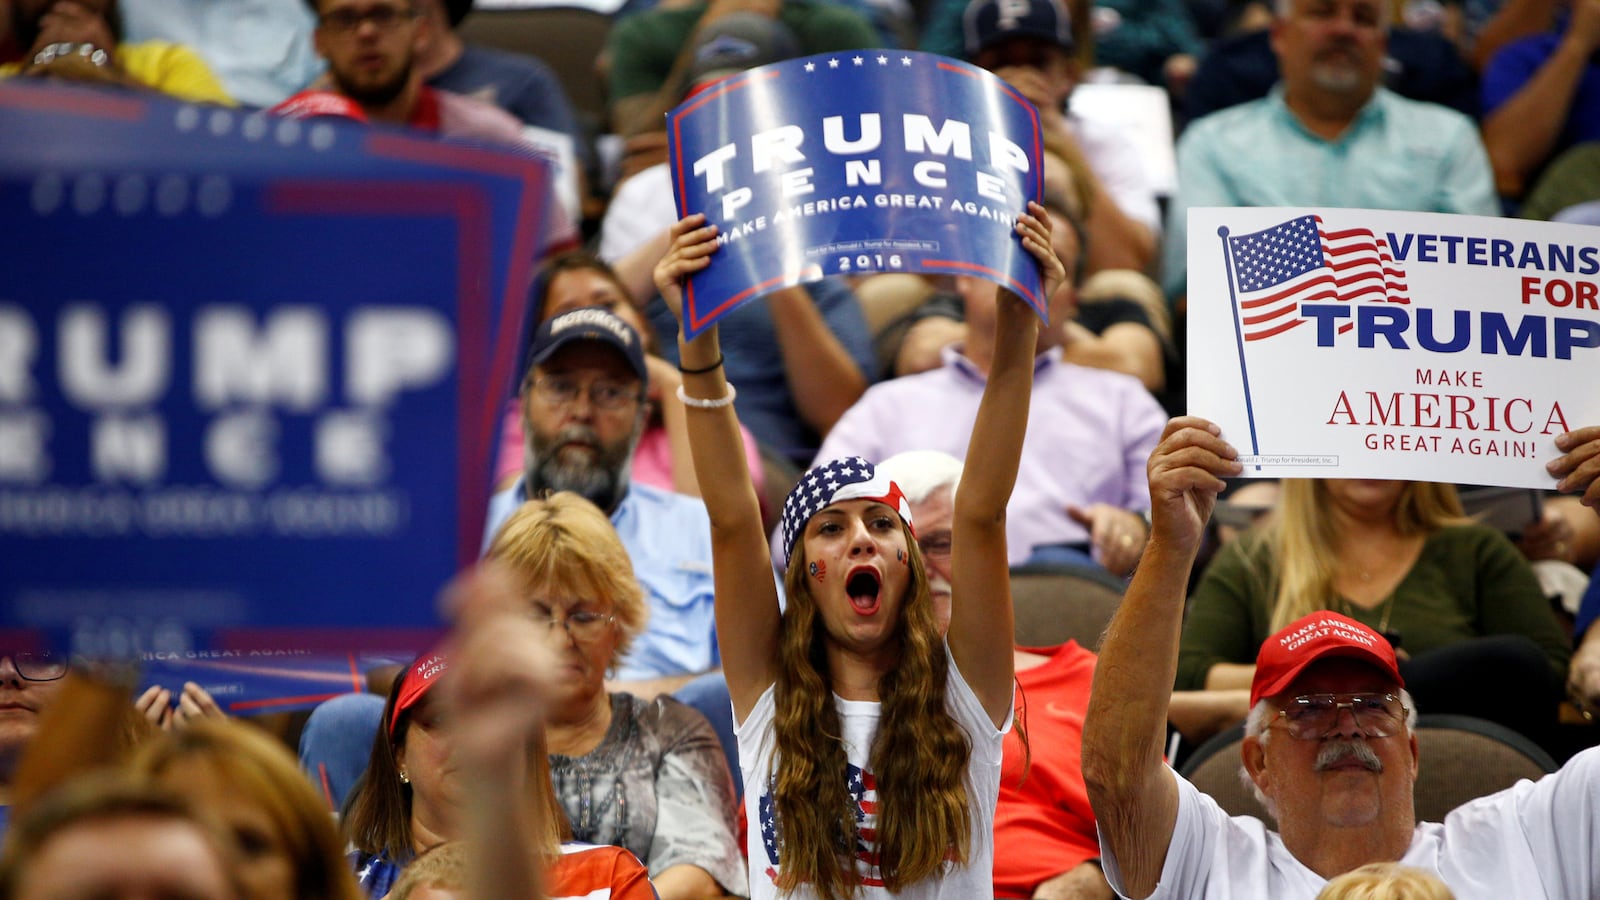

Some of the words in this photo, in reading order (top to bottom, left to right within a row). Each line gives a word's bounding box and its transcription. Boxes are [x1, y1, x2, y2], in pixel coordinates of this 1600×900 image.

[693, 112, 1030, 193] TRUMP
[722, 159, 1008, 222] PENCE
[716, 215, 767, 246] MAKE
[773, 195, 868, 223] AMERICA
[874, 194, 943, 209] GREAT
[839, 254, 902, 271] 2016
[1386, 232, 1600, 275] VETERANS
[1521, 276, 1600, 310] FOR
[1301, 304, 1600, 360] TRUMP
[1416, 369, 1483, 387] MAKE
[1326, 390, 1571, 434] AMERICA
[1261, 456, 1281, 465] Trump
[1291, 456, 1321, 465] President,
[1365, 433, 1442, 453] GREAT
[1450, 436, 1536, 459] AGAIN!
[1279, 622, 1317, 646] MAKE
[1319, 619, 1378, 642] AMERICA
[1288, 628, 1330, 651] GREAT
[1333, 628, 1373, 647] AGAIN
[417, 655, 448, 675] MAK
